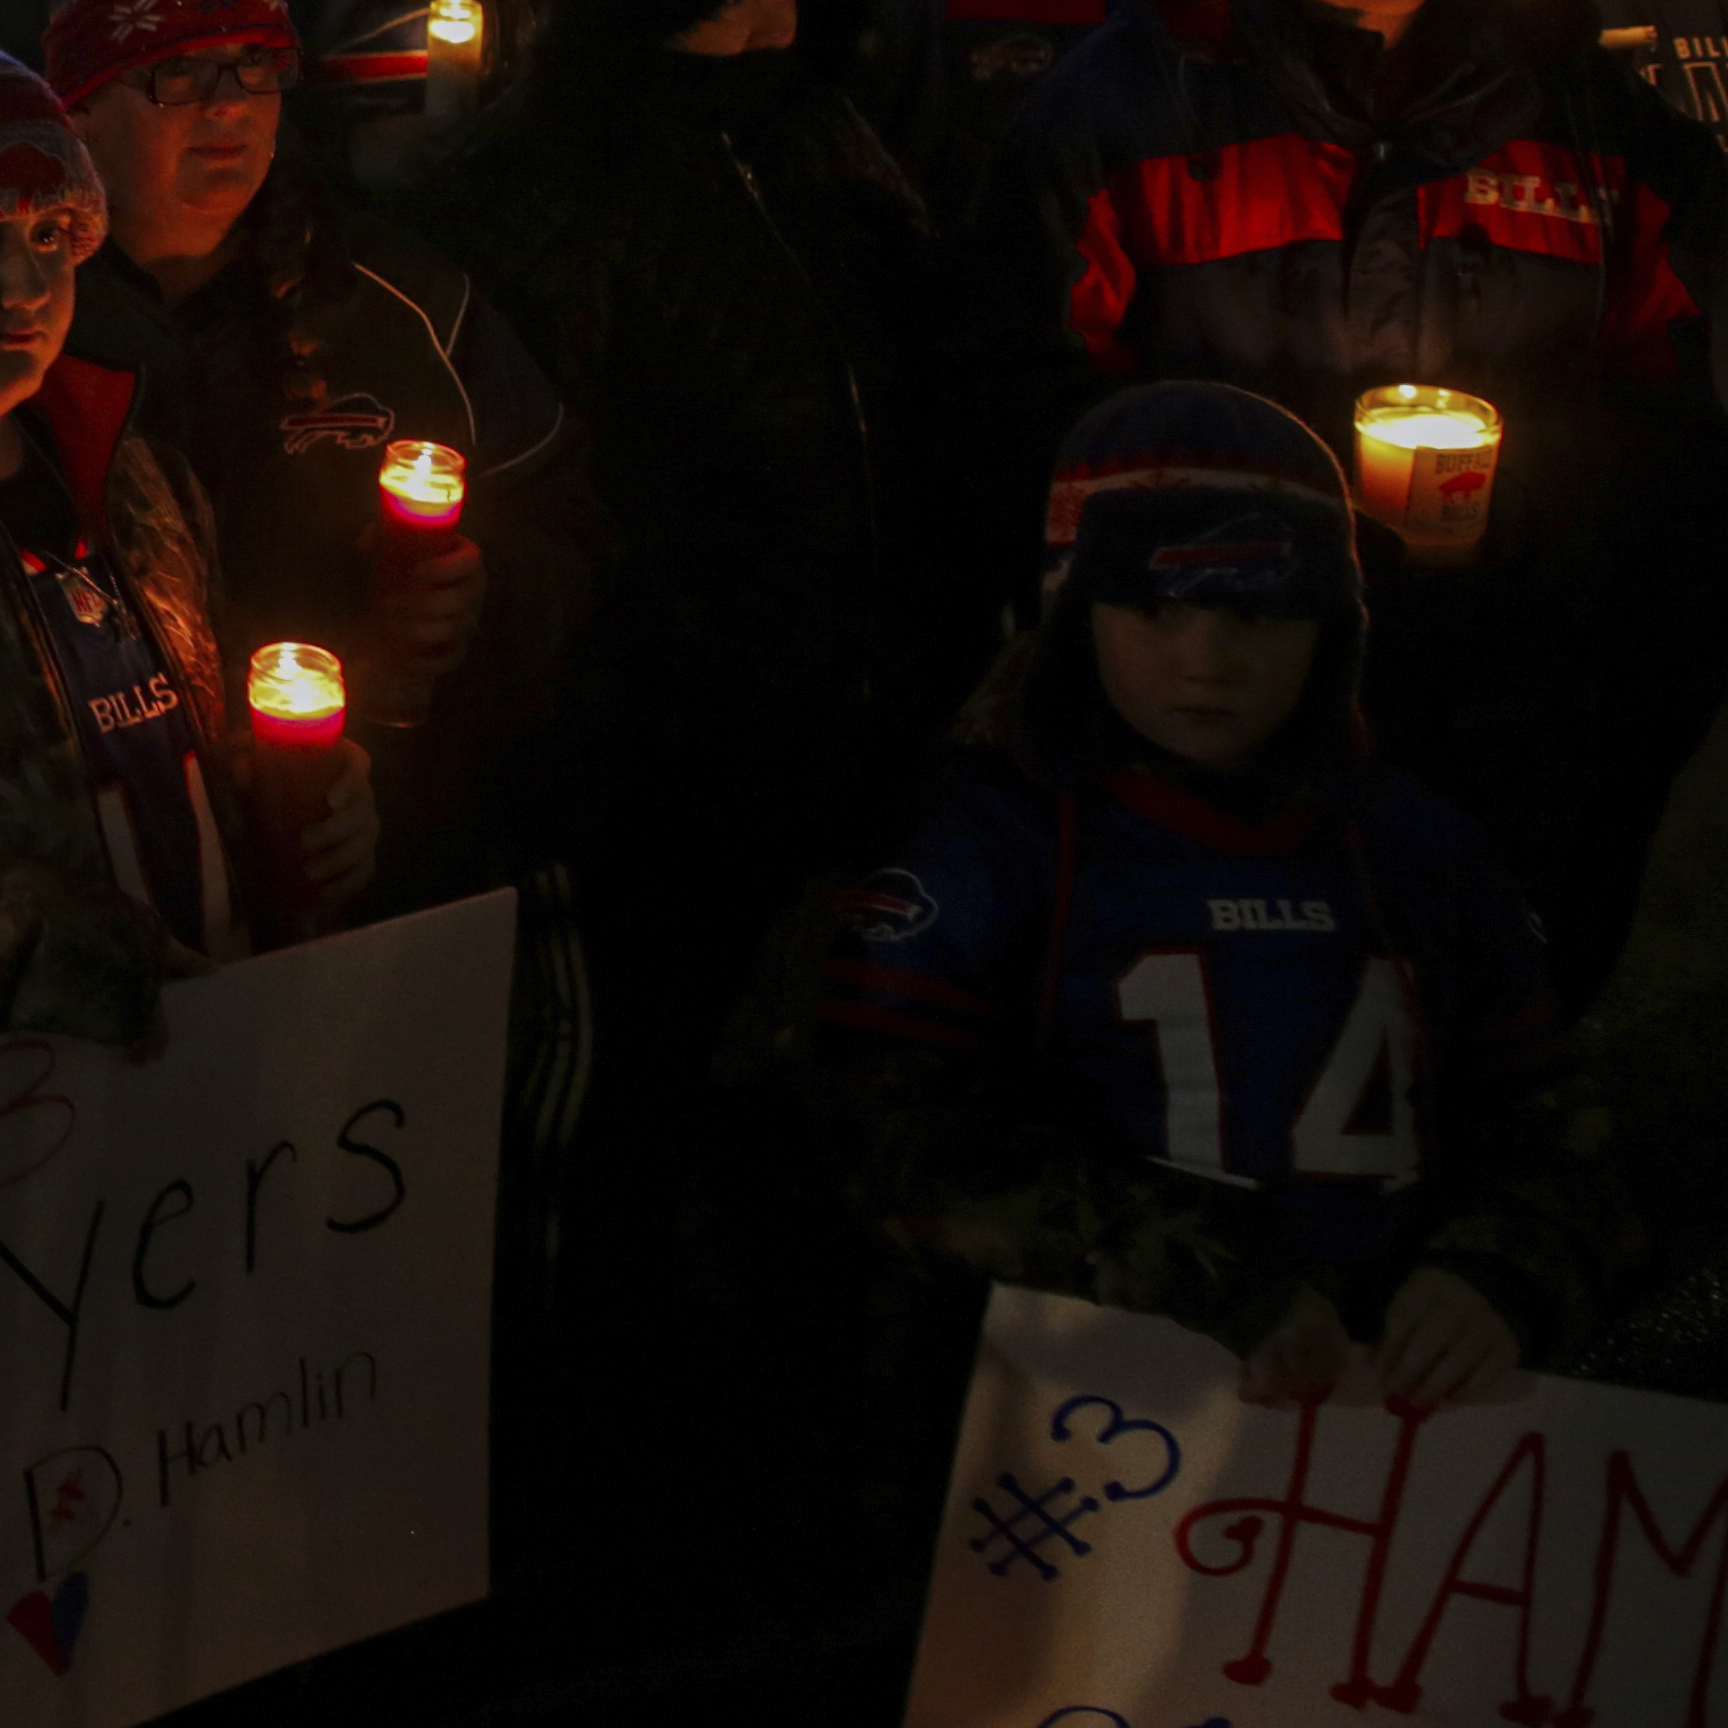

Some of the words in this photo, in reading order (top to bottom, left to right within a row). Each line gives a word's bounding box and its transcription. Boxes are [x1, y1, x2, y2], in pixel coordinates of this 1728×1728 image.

[87, 672, 181, 734] BILLS
[1205, 897, 1337, 933] BILLS
[1113, 941, 1422, 1184] 14
[157, 1349, 377, 1509] Hamlin
[971, 1393, 1182, 1580] #3
